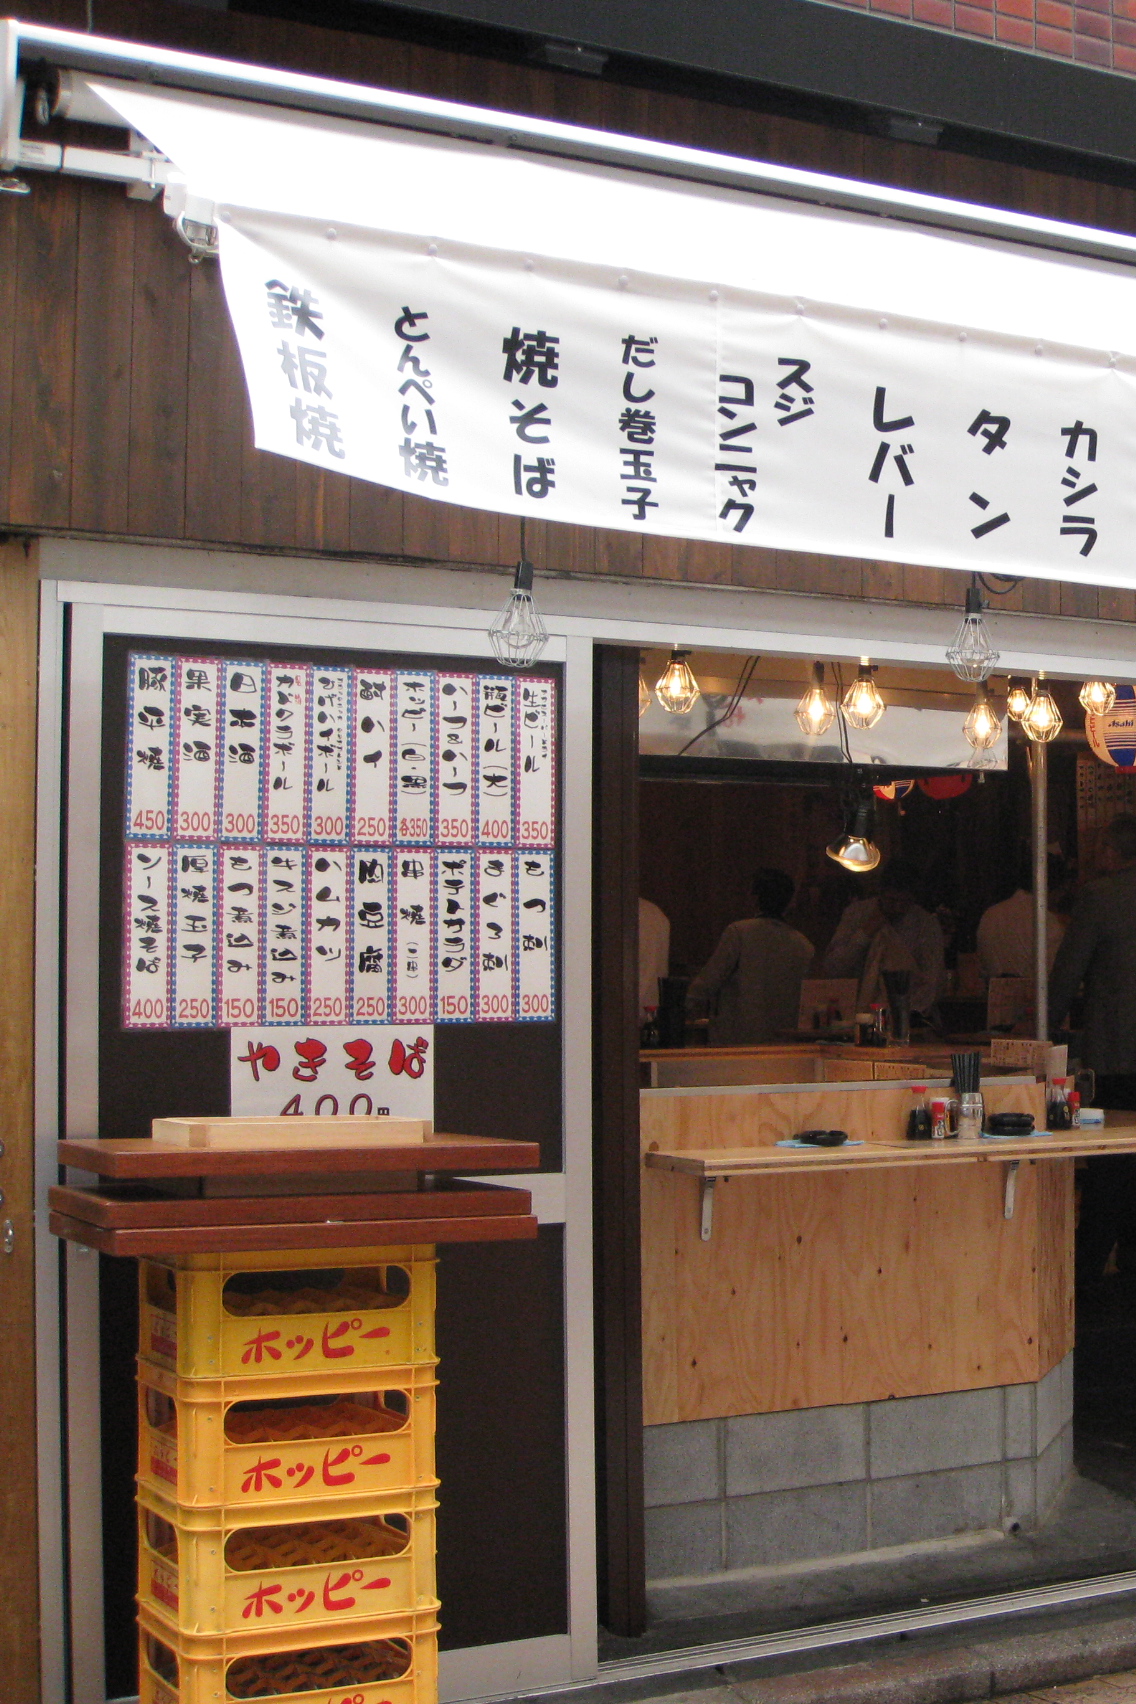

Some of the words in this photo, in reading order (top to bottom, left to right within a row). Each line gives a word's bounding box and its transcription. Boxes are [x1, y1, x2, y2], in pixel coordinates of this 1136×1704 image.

[264, 278, 346, 460] 鉄板焼
[774, 356, 815, 427] スジ
[394, 305, 450, 488] とんぺい焼
[502, 327, 560, 499] 焼そば
[619, 334, 659, 521] だし巻玉子
[715, 374, 757, 533] コンニャク
[869, 386, 915, 538] レバー
[967, 408, 1011, 539] タン
[1060, 419, 1098, 557] カシラ
[183, 668, 212, 762] 果実酒
[229, 671, 257, 764] 日本酒
[360, 679, 386, 768] 酎ハイ
[1107, 719, 1134, 729] Asahi
[133, 810, 165, 830] 450
[180, 811, 212, 832] 300
[225, 812, 256, 833] 300
[270, 814, 300, 834] 350
[314, 816, 344, 835] 300
[357, 817, 386, 836] 250
[440, 819, 469, 837] 350
[481, 820, 509, 838] 400
[522, 821, 549, 840] 350
[226, 856, 254, 973] もつ煮込み
[315, 858, 342, 962] ハムカツ
[441, 859, 467, 972] ポテトサラダ
[482, 859, 509, 972] まぐろ刺
[523, 860, 548, 951] もつ刺
[132, 999, 164, 1019] 400
[178, 998, 210, 1019] 250
[226, 998, 254, 1018] 150
[271, 997, 299, 1018] 150
[313, 997, 343, 1017] 250
[356, 997, 385, 1017] 250
[399, 996, 427, 1015] 300
[441, 995, 468, 1014] 150
[481, 994, 509, 1014] 300
[522, 994, 549, 1013] 300
[238, 1036, 430, 1082] やきそば
[241, 1318, 391, 1364] ホッピー
[241, 1445, 391, 1493] ホッピー
[242, 1569, 391, 1619] ホッピー
